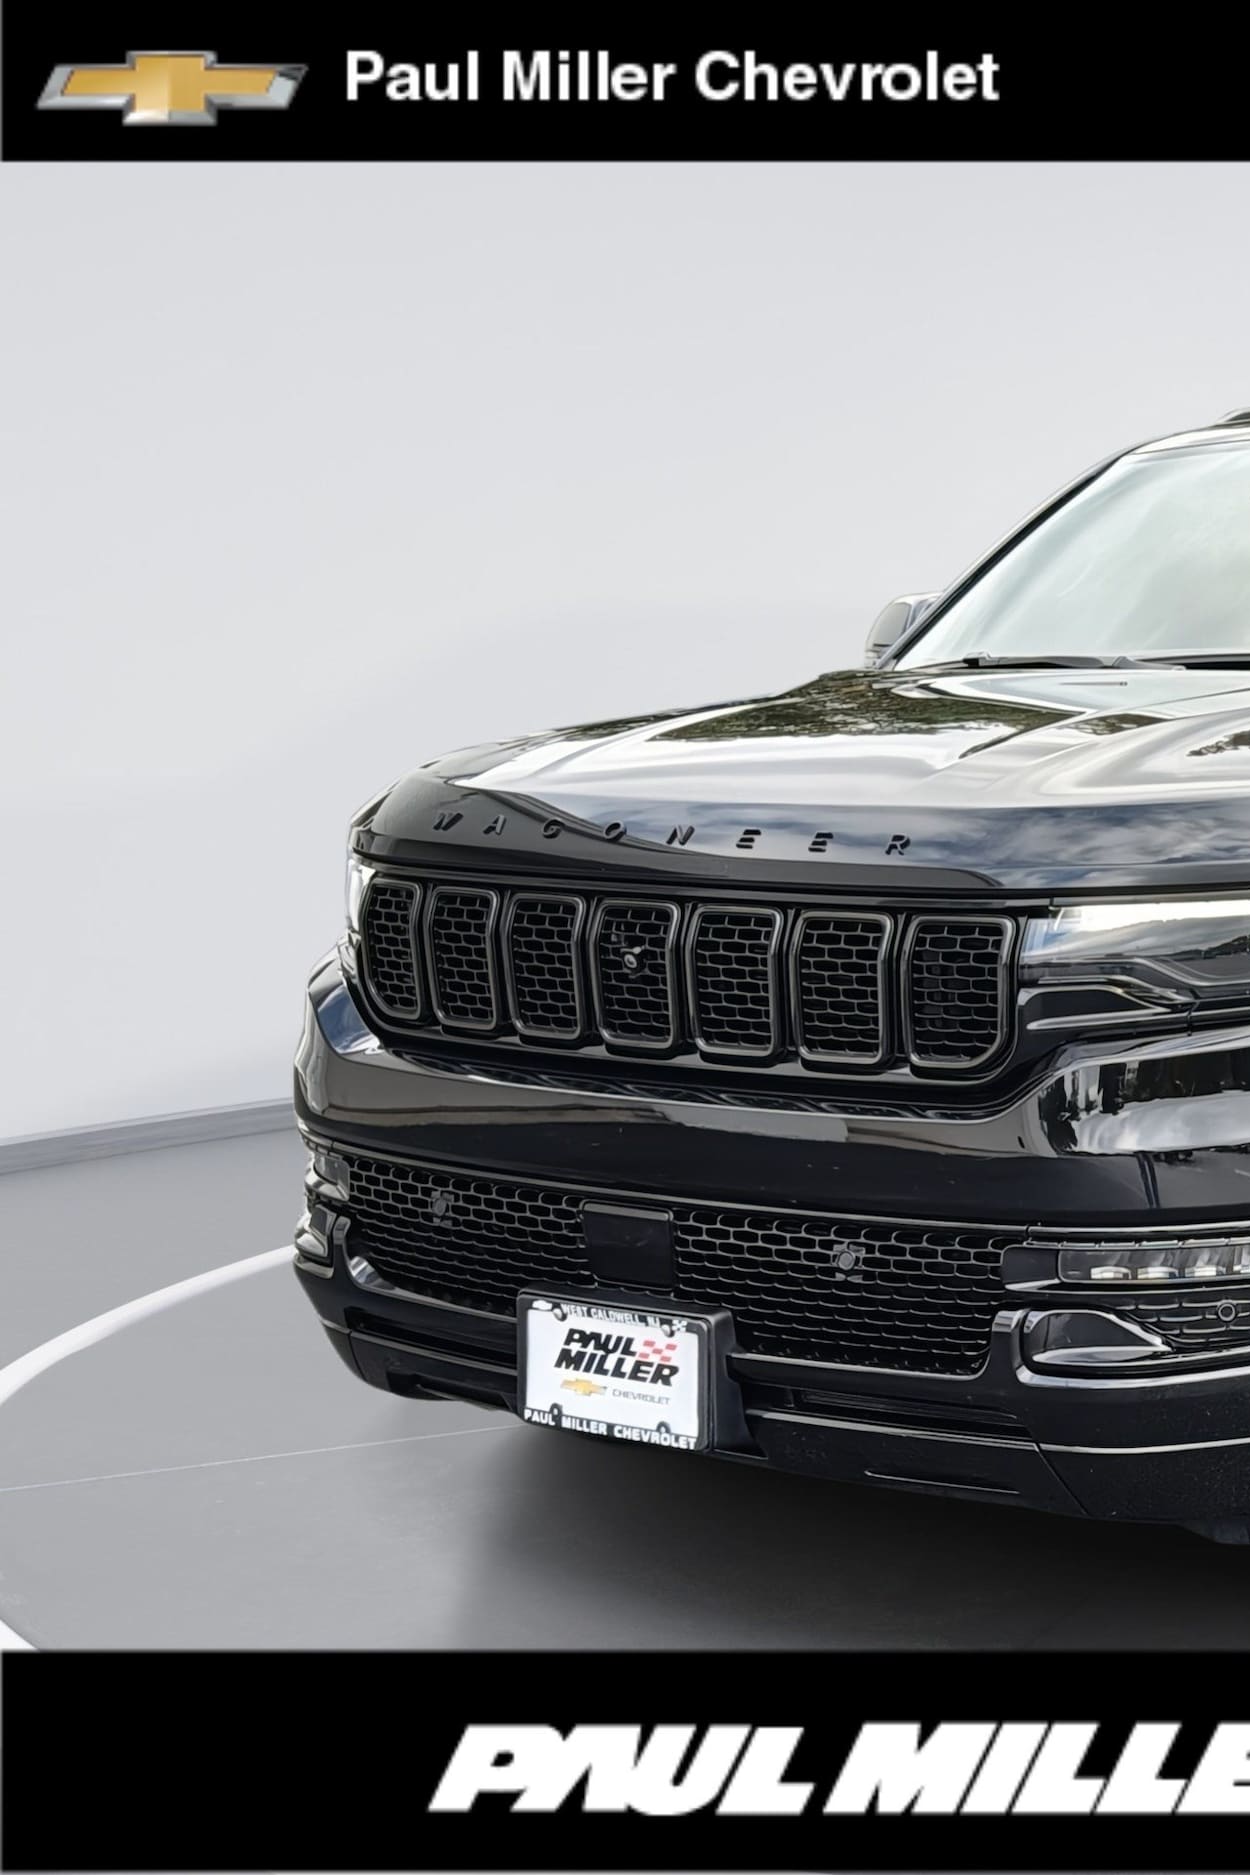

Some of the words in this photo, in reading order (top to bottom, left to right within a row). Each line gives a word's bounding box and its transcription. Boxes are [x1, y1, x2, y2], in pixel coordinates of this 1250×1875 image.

[432, 812, 912, 856] WAGONEER
[560, 1303, 588, 1318] WEST
[564, 1328, 636, 1357] PAUL
[554, 1348, 680, 1387] MILLER
[612, 1388, 671, 1405] CHEVROLET
[523, 1408, 556, 1427] PAUL
[561, 1416, 608, 1436] MILLER
[613, 1425, 697, 1450] CHEVROLET
